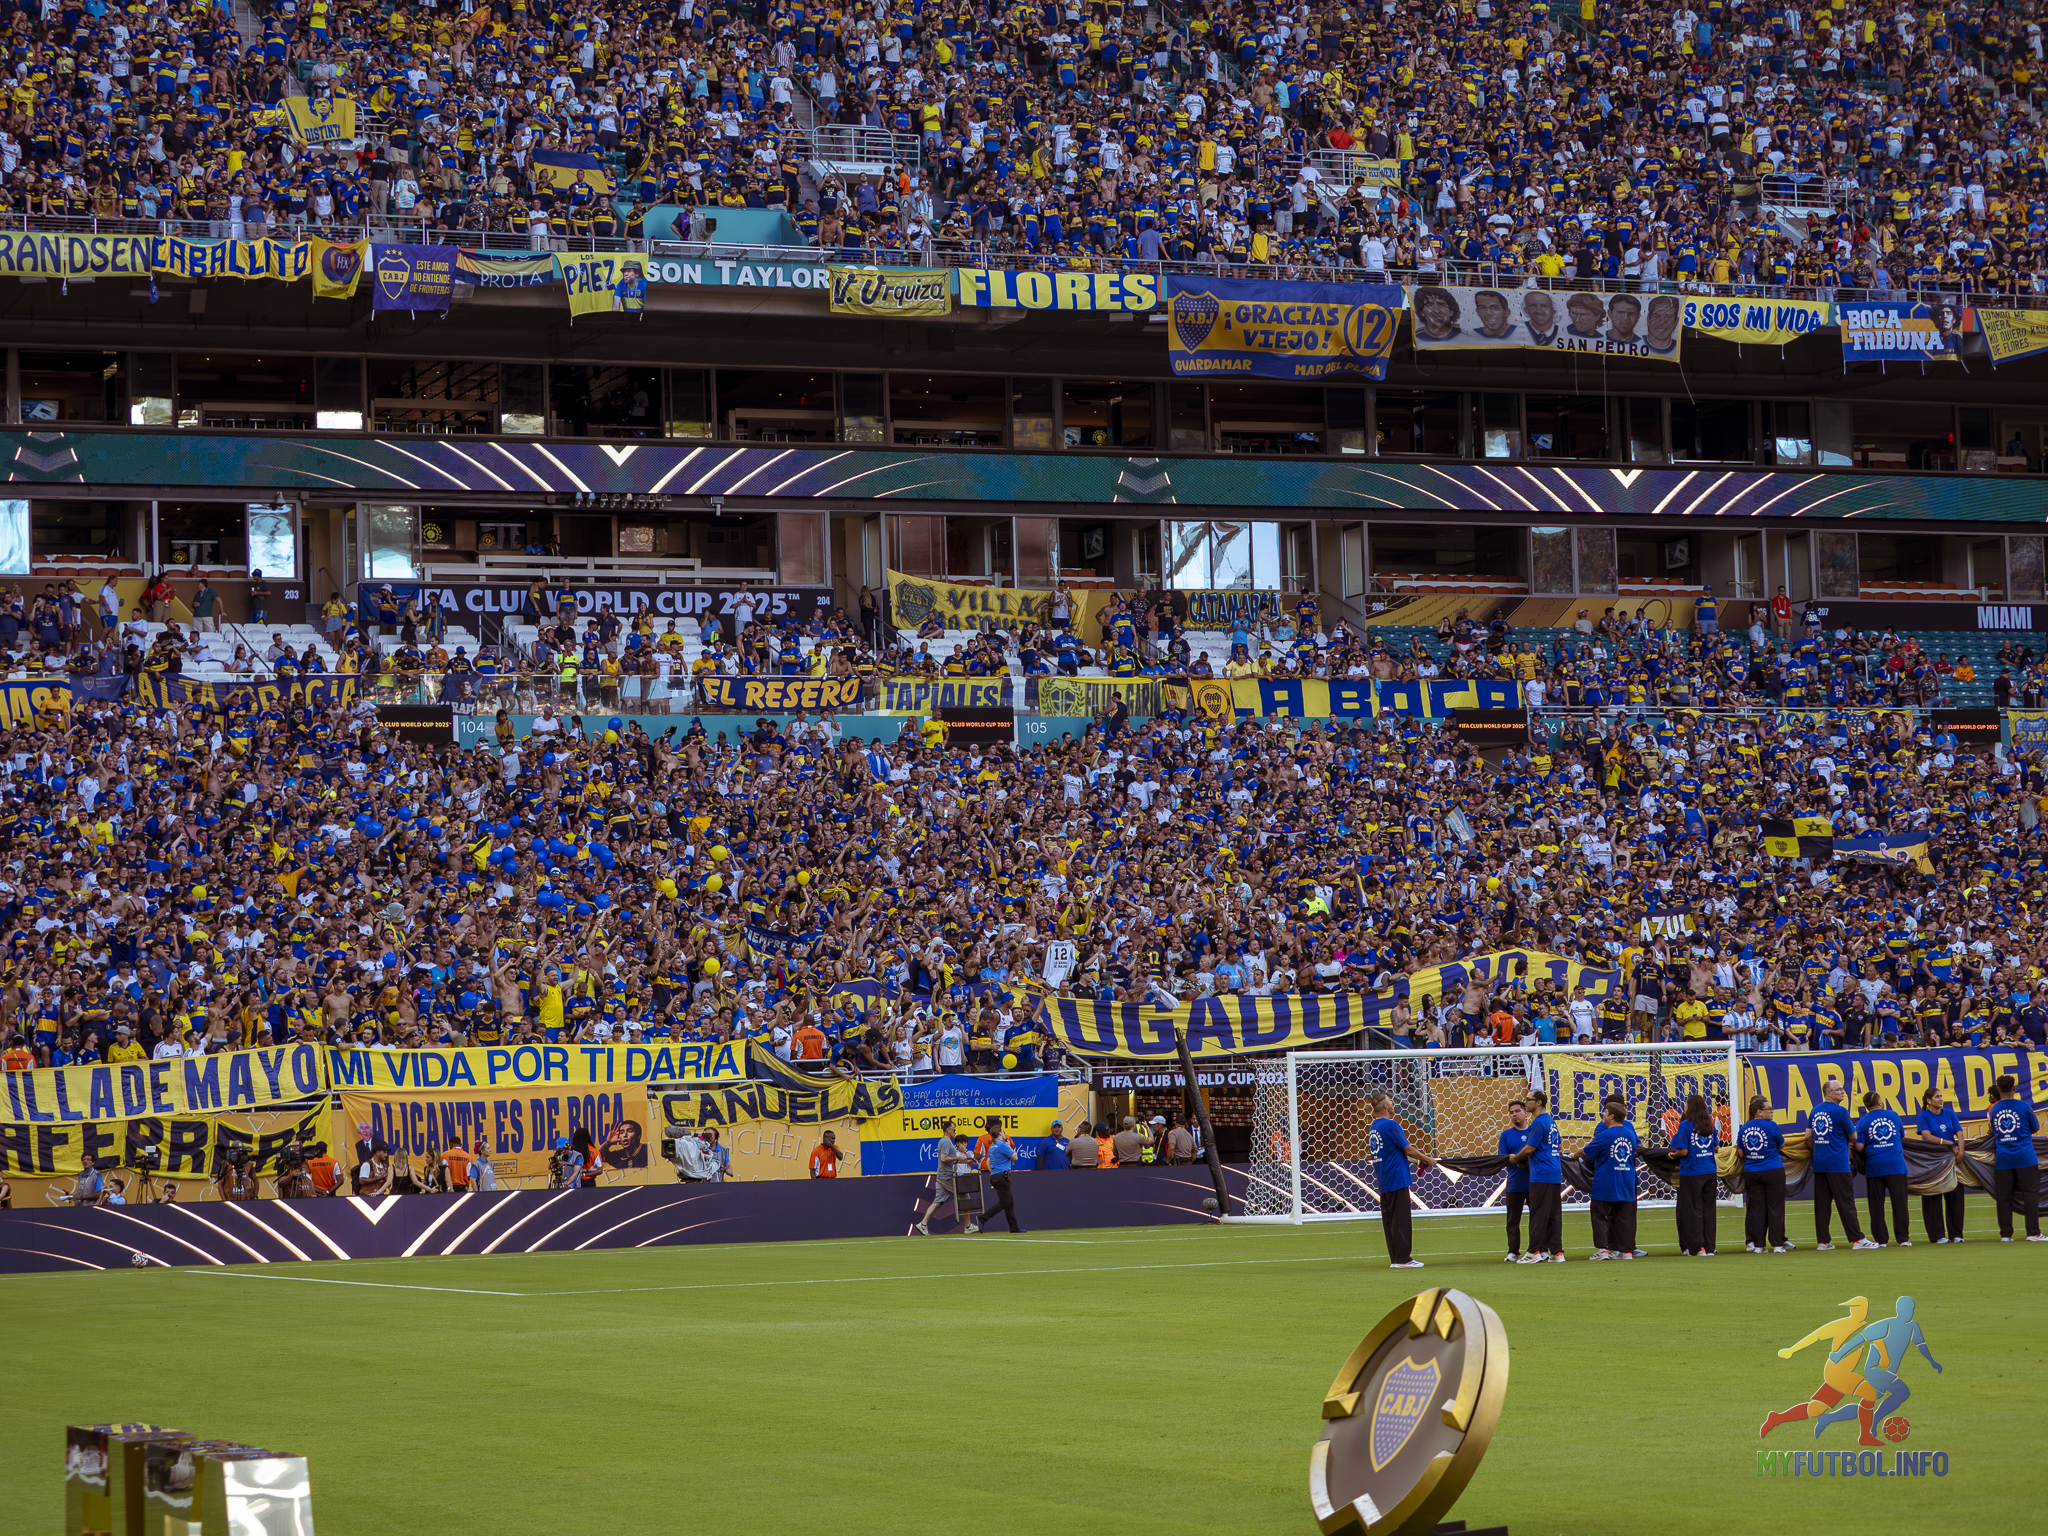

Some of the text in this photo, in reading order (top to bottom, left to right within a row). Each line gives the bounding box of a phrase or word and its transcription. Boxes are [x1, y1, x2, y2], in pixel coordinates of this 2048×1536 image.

[152, 237, 309, 277] CABALLITO
[416, 261, 449, 272] ESTE AMOR
[383, 272, 404, 280] CABJ
[413, 272, 451, 284] NO ENTIENDE
[480, 271, 544, 288] PROTA
[563, 259, 617, 296] PAEZ
[410, 284, 451, 295] DE FRONTERAS
[860, 273, 945, 308] Urquiza
[958, 267, 1157, 311] FLORES
[1176, 311, 1213, 324] CABJ
[1224, 304, 1340, 330] ¡GRACIAS
[1699, 302, 1741, 329] SOS
[1745, 303, 1772, 332] MI
[1776, 305, 1824, 334] VIDA
[1846, 309, 1903, 330] BOCA
[1355, 308, 1387, 350] 12
[2000, 327, 2027, 343] QUIERO
[1243, 329, 1333, 350] VIEJO!
[1556, 337, 1650, 357] SAN PEDRO
[1848, 330, 1945, 350] TRIBUNA
[1992, 344, 2002, 356] DE
[1174, 358, 1253, 371] GUARDAMAR
[1294, 361, 1341, 376] MAR DEL
[284, 589, 300, 600] 203
[465, 589, 528, 612] CLU
[656, 590, 712, 614] CUP
[817, 596, 831, 605] 204
[947, 589, 1036, 617] VILLA
[1371, 602, 1385, 611] 206
[1818, 607, 1829, 617] 207
[1977, 605, 2033, 629] MIAMI
[702, 676, 860, 708] EL RESERO
[880, 682, 1001, 712] TAPIALES
[461, 721, 485, 733] 104
[1025, 722, 1047, 734] 105
[1640, 913, 1694, 942] AZUL
[1054, 947, 1068, 960] 12
[331, 1044, 740, 1087] MI VIDA POR TI DARIA
[184, 1043, 320, 1111] MAYO
[1102, 1075, 1133, 1088] FIFA
[1135, 1074, 1171, 1088] CLUB
[1174, 1072, 1225, 1087] WRLD
[1228, 1072, 1255, 1085] CUP
[913, 1090, 931, 1100] HAY
[1755, 1063, 1814, 1126] LA
[1816, 1056, 1962, 1119] BARRA
[1963, 1052, 2021, 1112] DE
[662, 1082, 901, 1128] CAÑUELAS
[923, 1098, 956, 1106] SEPARE
[959, 1097, 969, 1105] DE
[974, 1097, 997, 1105] ESTA
[370, 1100, 487, 1157] ALICANTE
[494, 1098, 524, 1154] ES
[530, 1096, 560, 1152] DE
[957, 1117, 972, 1126] DEL
[1380, 1392, 1427, 1417] CABJ
